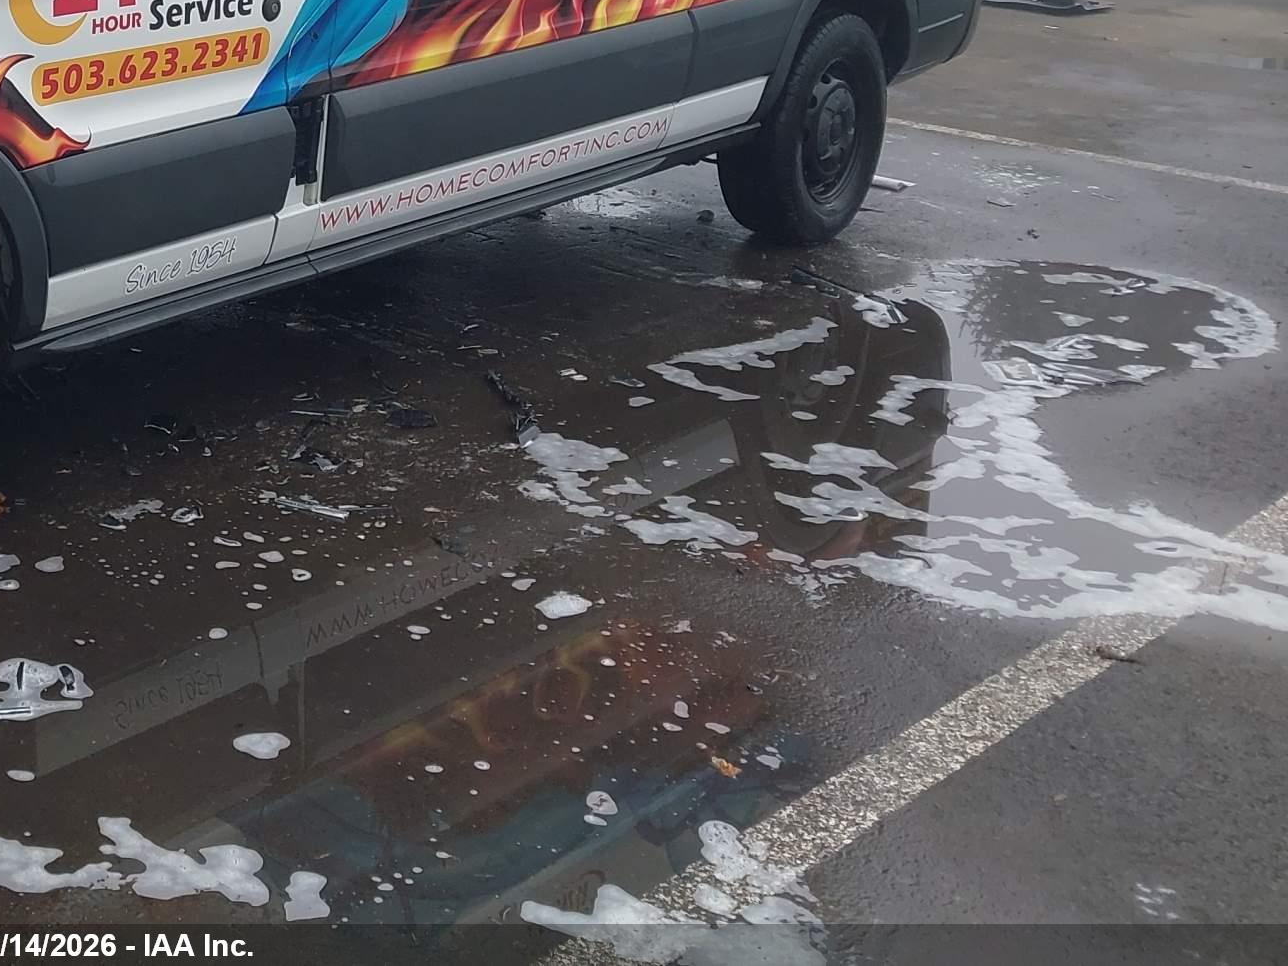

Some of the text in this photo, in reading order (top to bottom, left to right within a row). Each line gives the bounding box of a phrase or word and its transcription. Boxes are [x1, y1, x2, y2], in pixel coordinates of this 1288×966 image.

[91, 11, 143, 35] HOUR
[41, 31, 264, 100] 503.623.2341
[318, 114, 669, 232] WWW.HOMECOMFORTINC.COM
[123, 237, 237, 296] Since 1954
